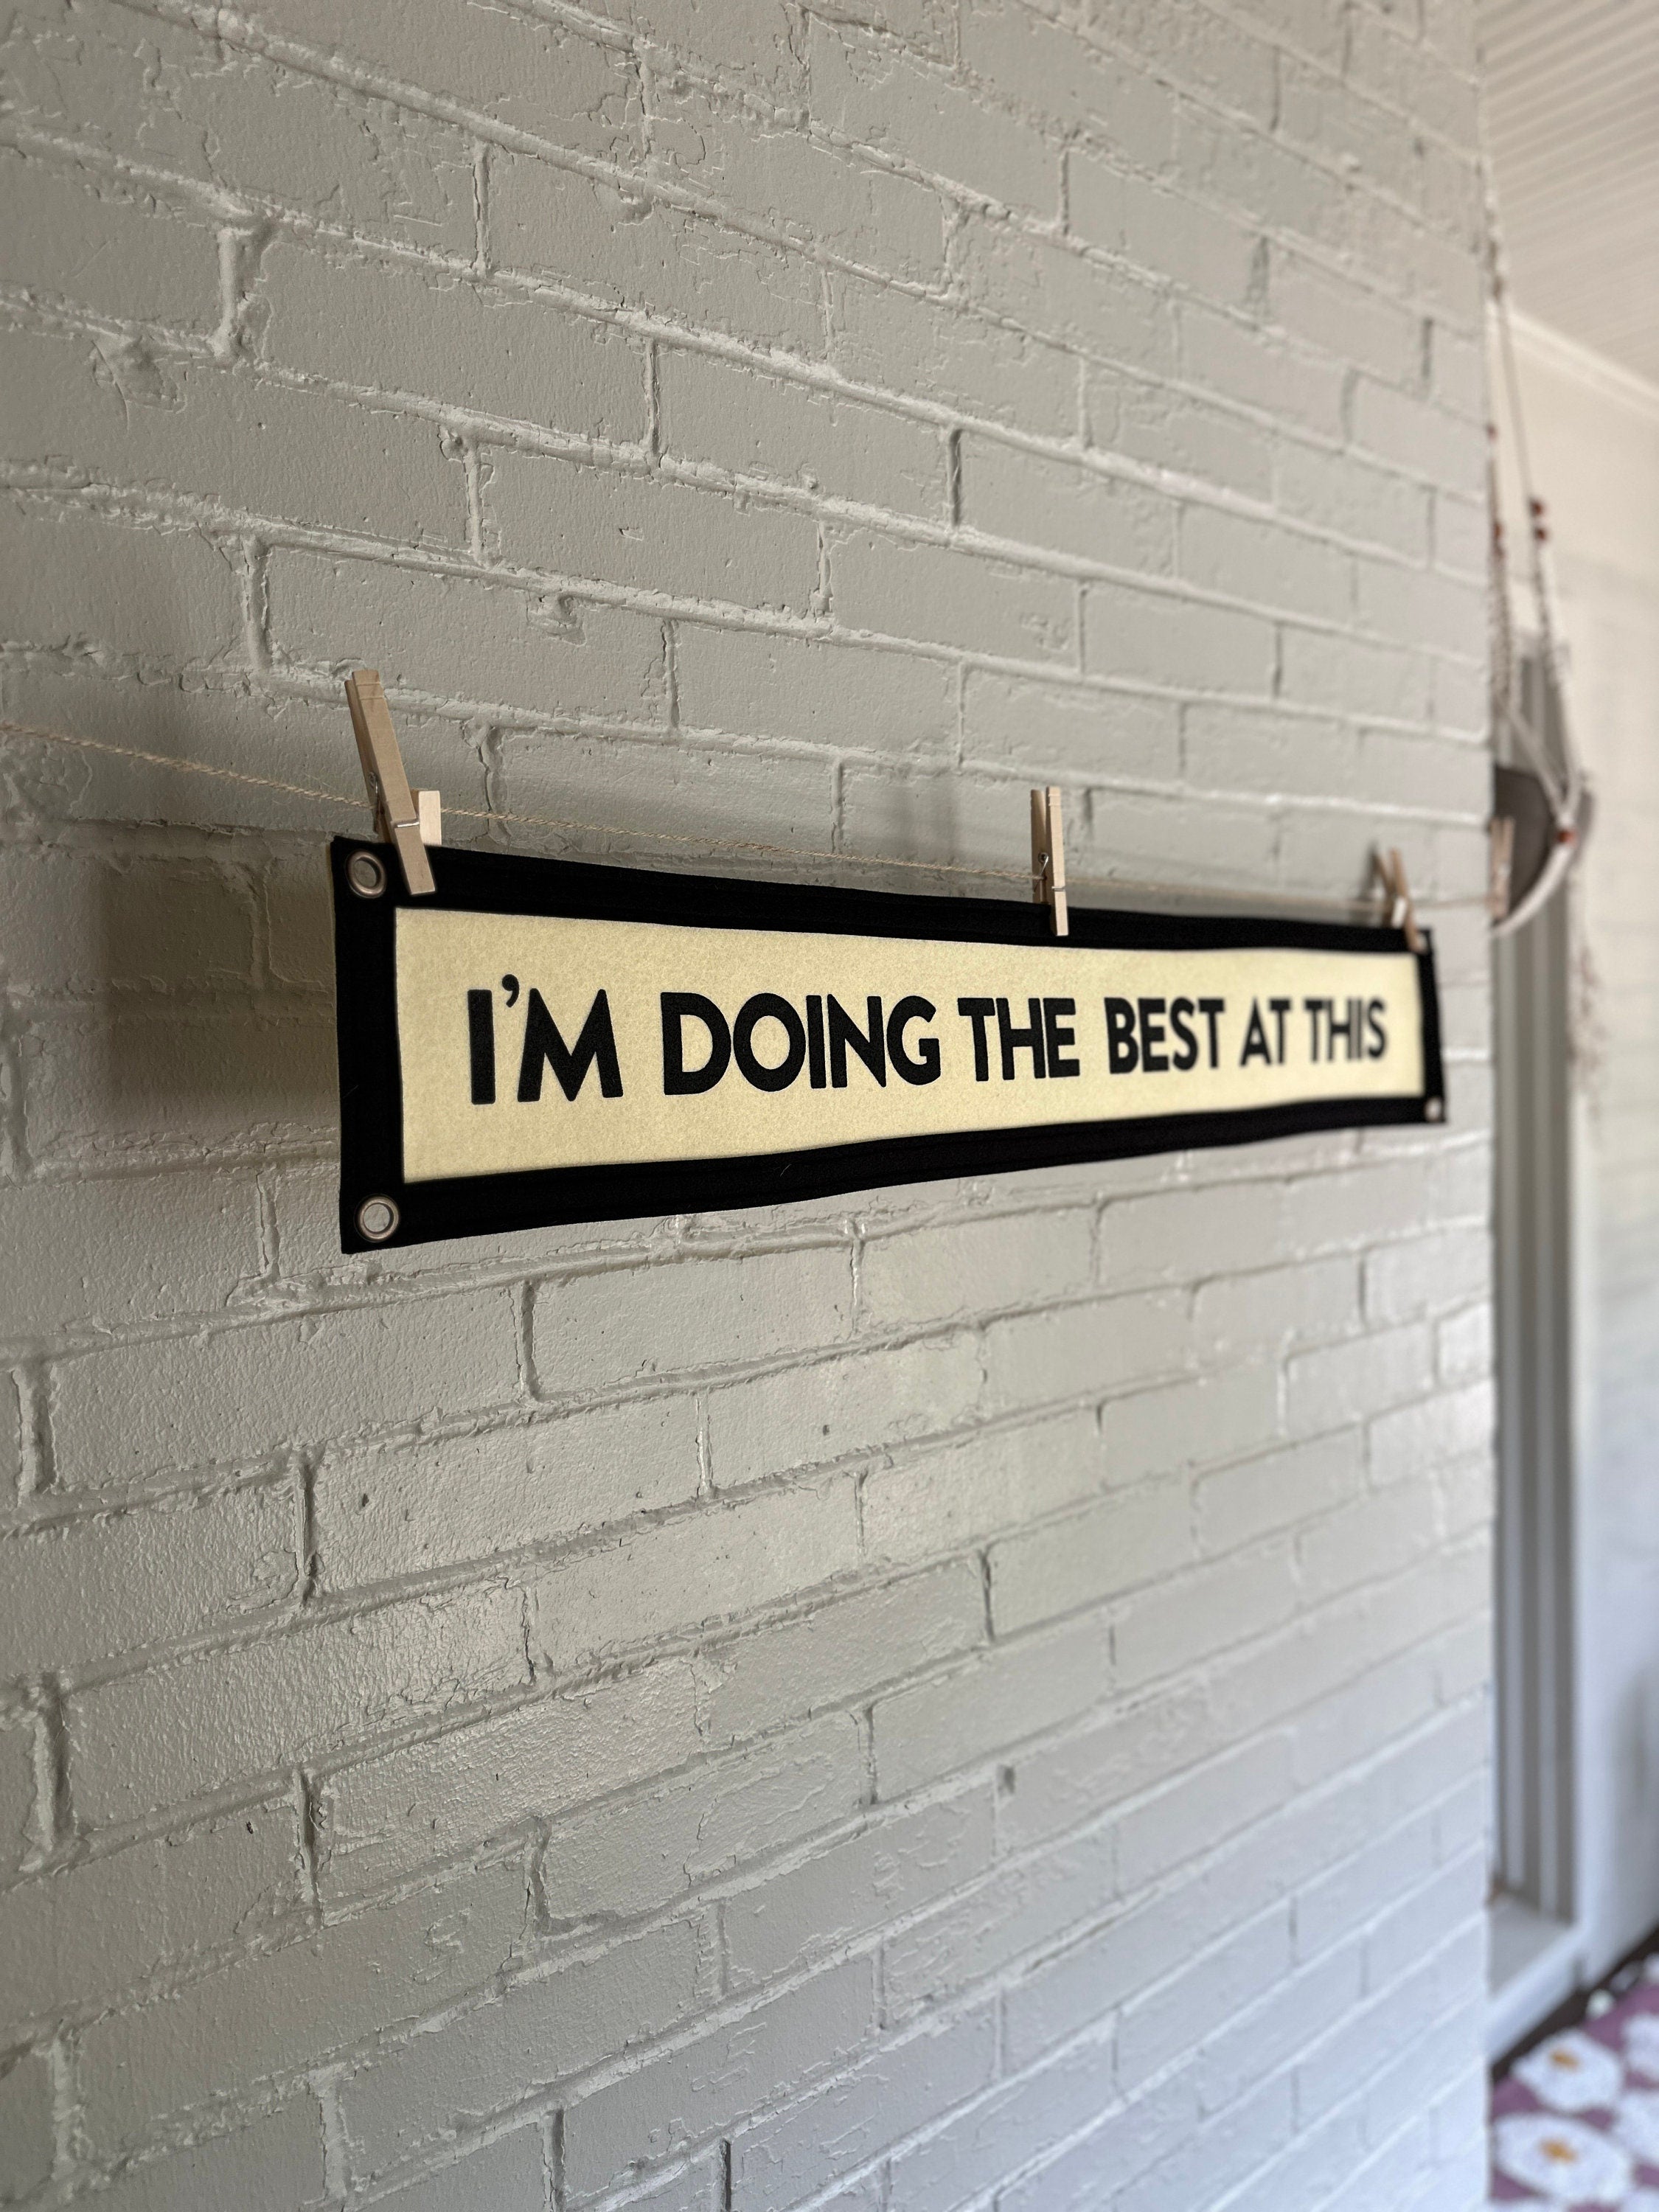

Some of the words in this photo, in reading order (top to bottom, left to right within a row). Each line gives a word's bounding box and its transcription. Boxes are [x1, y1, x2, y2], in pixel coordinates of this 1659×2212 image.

[467, 973, 624, 1105] I'M
[660, 991, 942, 1096] DOING
[957, 997, 1080, 1082] THE
[1104, 997, 1225, 1074] BEST
[1239, 998, 1292, 1068] AT
[1304, 998, 1387, 1065] THIS
